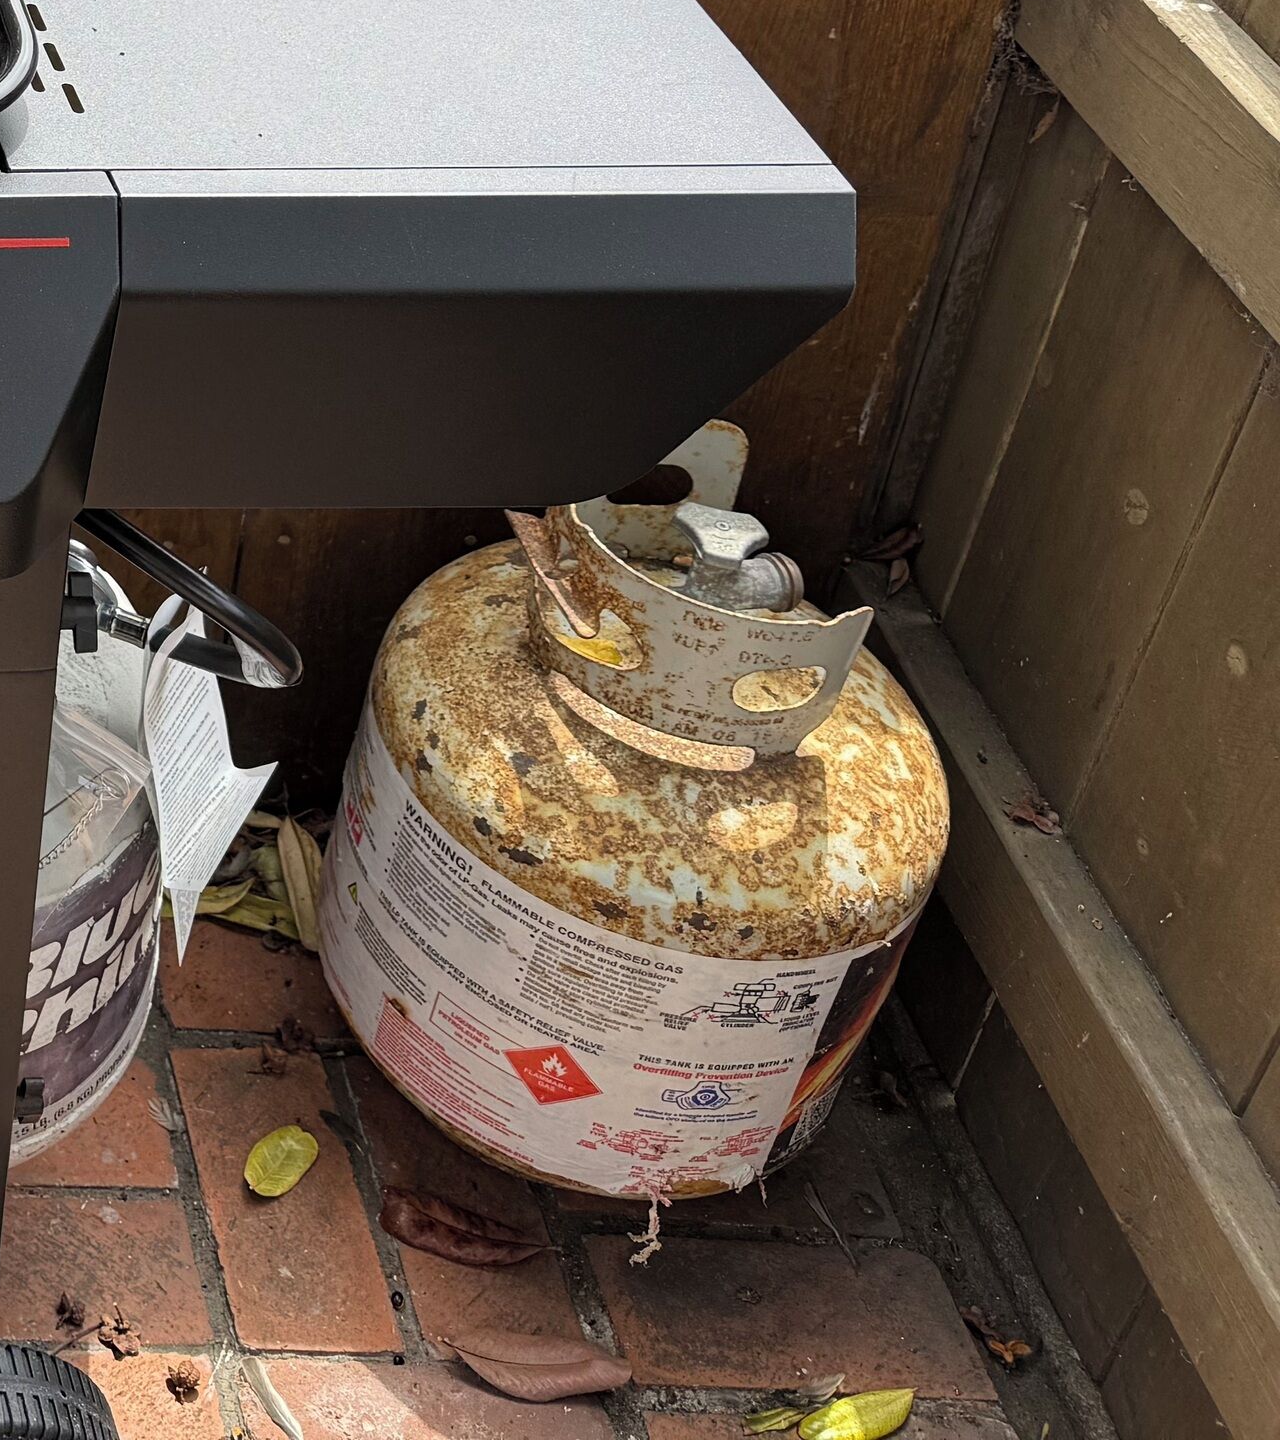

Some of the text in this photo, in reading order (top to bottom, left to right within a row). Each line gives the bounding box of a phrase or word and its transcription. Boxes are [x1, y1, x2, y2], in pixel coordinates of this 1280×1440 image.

[405, 798, 474, 877] WARNING!
[481, 878, 685, 976] FLAMMABLE COMPRESSED GAS
[399, 916, 420, 937] TANK
[424, 943, 466, 979] EQUIPPED
[464, 976, 489, 996] WITH
[496, 997, 535, 1022] SAFETY
[535, 1017, 571, 1039] RELIEF
[572, 1032, 606, 1052] VALVE.
[596, 954, 618, 969] and
[618, 963, 680, 985] explosions.
[437, 1009, 500, 1055] PETROLEUM GAS
[463, 982, 513, 1018] ENCLOSED
[512, 1014, 528, 1026] OR
[528, 1022, 568, 1045] HEATED
[569, 1042, 600, 1057] AREA.
[523, 1067, 574, 1093] FLAMMABLE
[632, 1061, 791, 1081] Overfilling Prevention Device
[638, 1053, 795, 1071] THIS TANK IS EQUIPPED WITH AN
[537, 1079, 556, 1092] GAS
